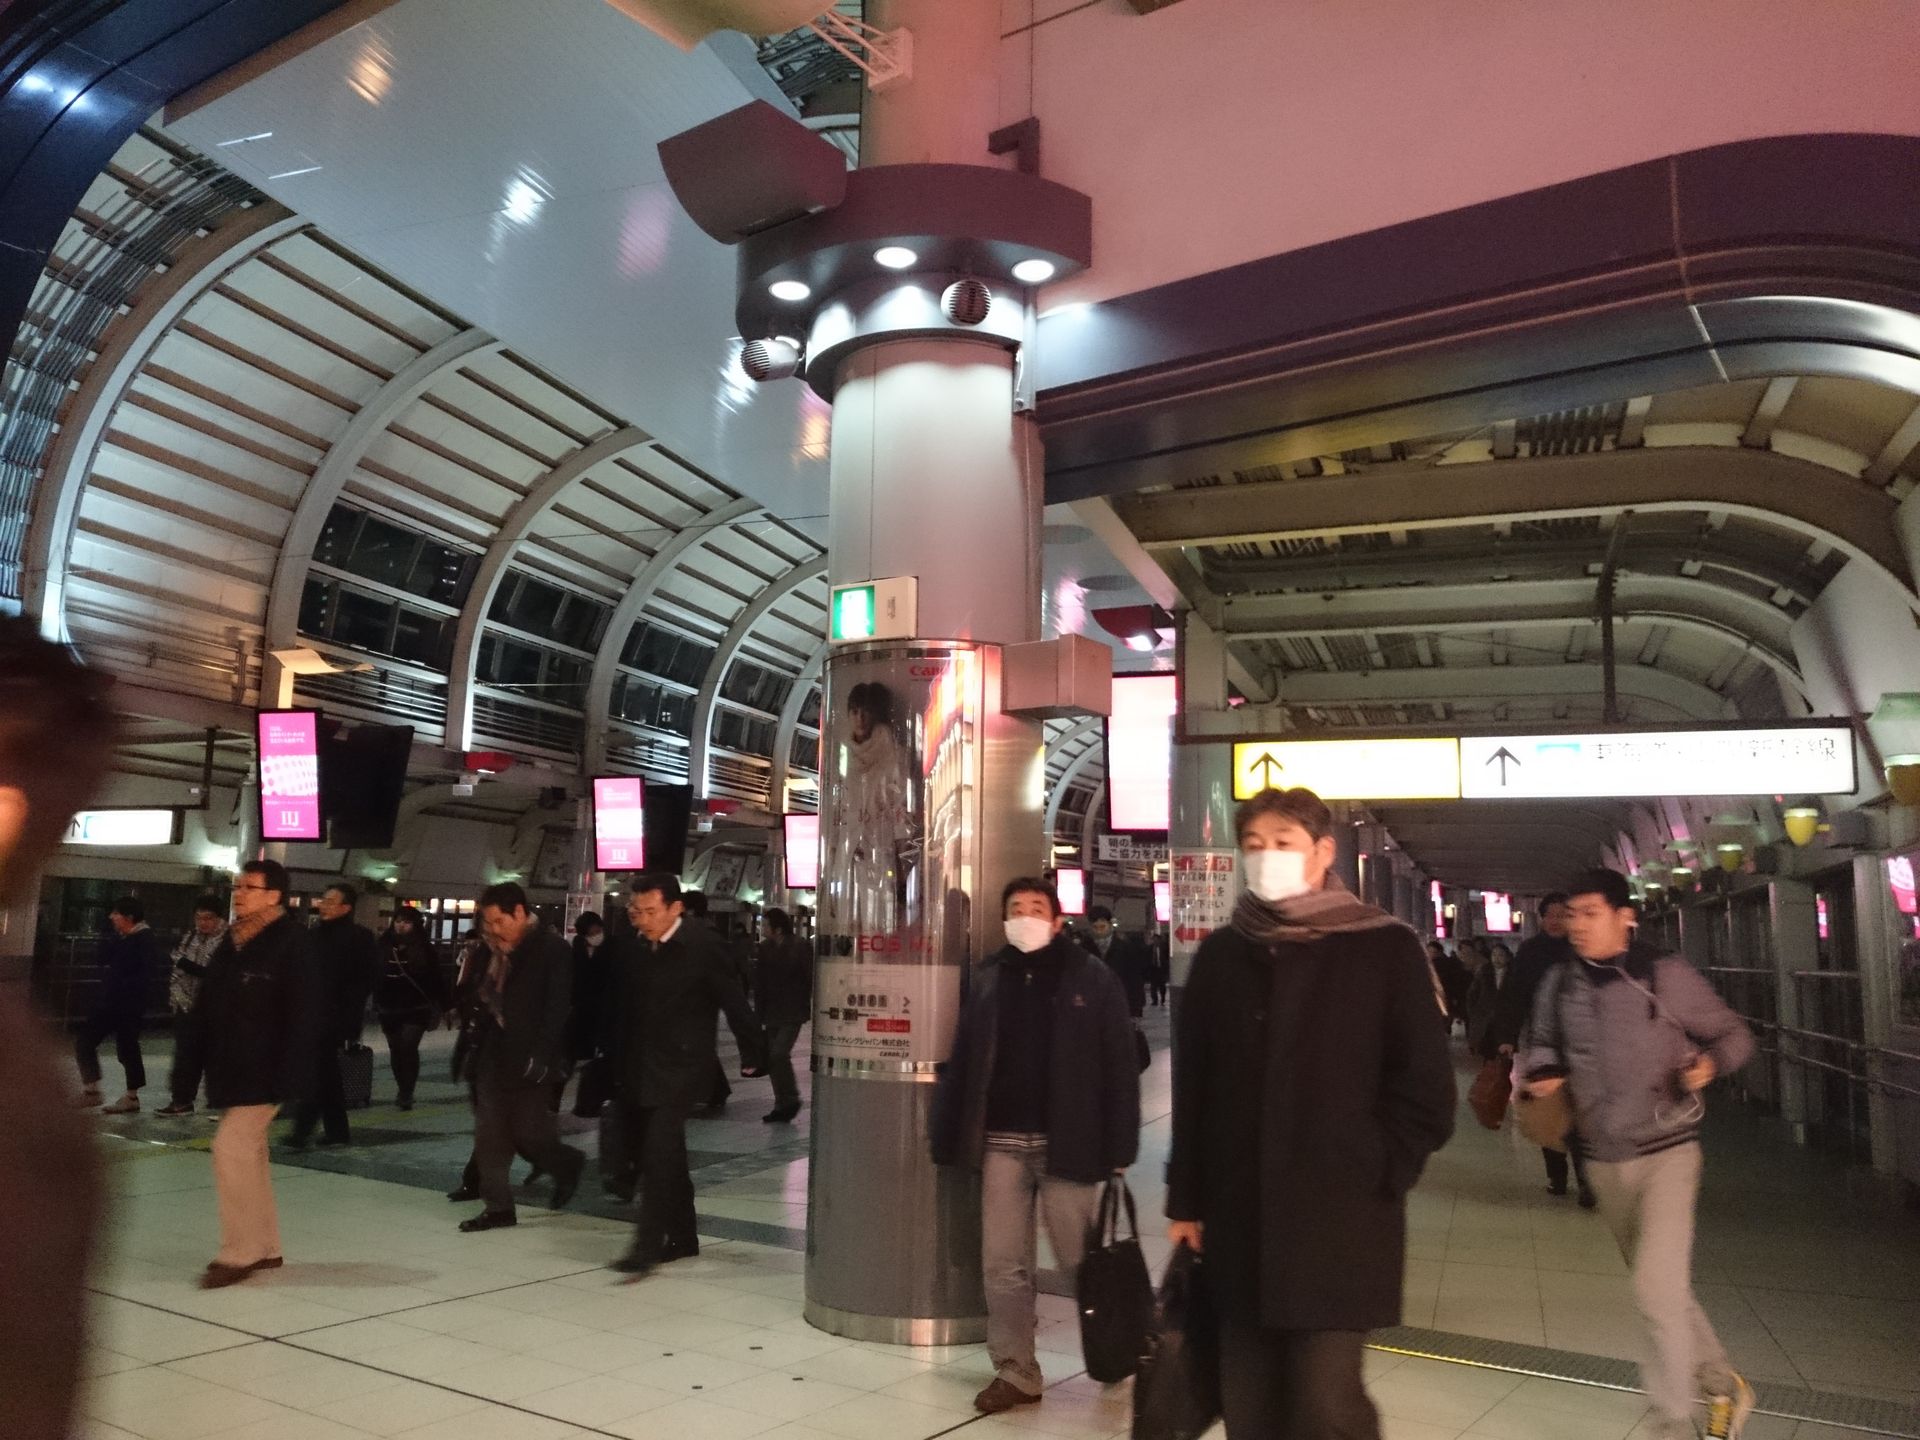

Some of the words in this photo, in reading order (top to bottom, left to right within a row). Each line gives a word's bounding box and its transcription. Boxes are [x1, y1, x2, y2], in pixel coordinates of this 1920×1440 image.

[280, 810, 300, 827] IIJ
[1108, 848, 1168, 859] ご協力をお
[859, 934, 901, 952] EOS
